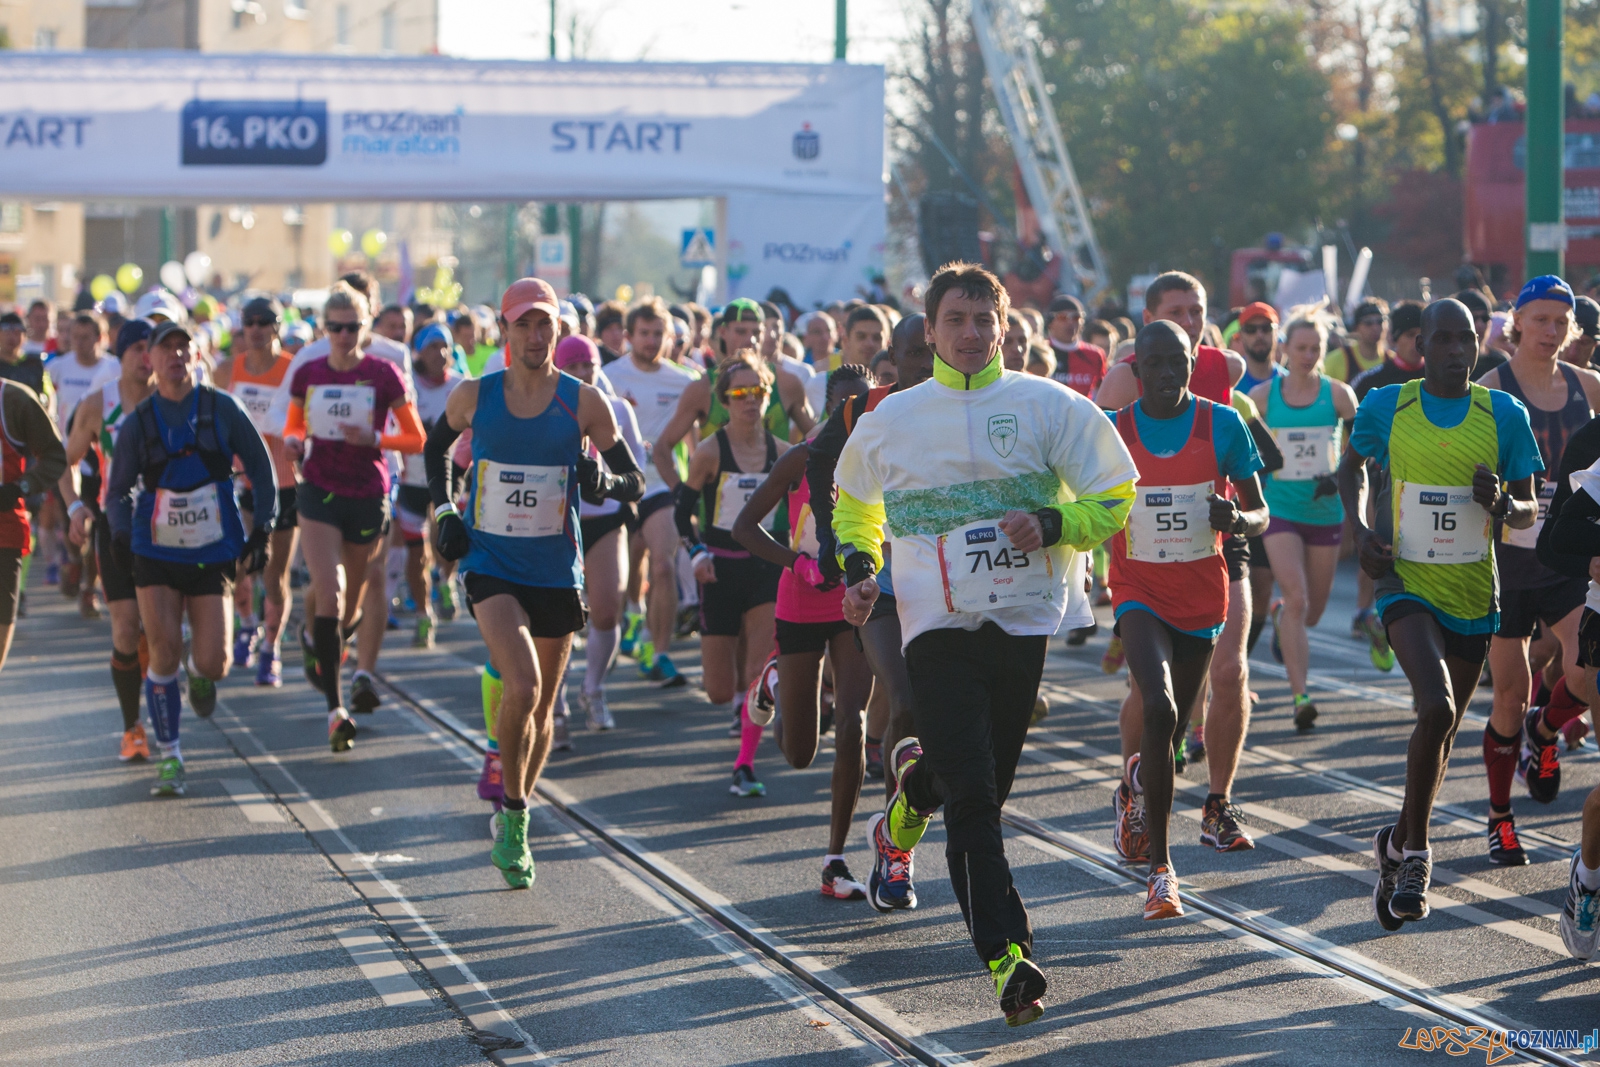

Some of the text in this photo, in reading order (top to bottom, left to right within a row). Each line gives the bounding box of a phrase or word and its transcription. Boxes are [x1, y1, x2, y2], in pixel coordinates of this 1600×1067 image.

[190, 115, 319, 149] 16. PKO
[551, 120, 691, 152] START
[327, 402, 351, 418] 48
[1294, 444, 1316, 458] 24
[505, 489, 537, 508] 46
[1156, 512, 1188, 531] 55
[1432, 511, 1457, 531] 16
[968, 533, 979, 541] 16.
[979, 530, 994, 539] PKO
[965, 547, 1030, 574] 7143
